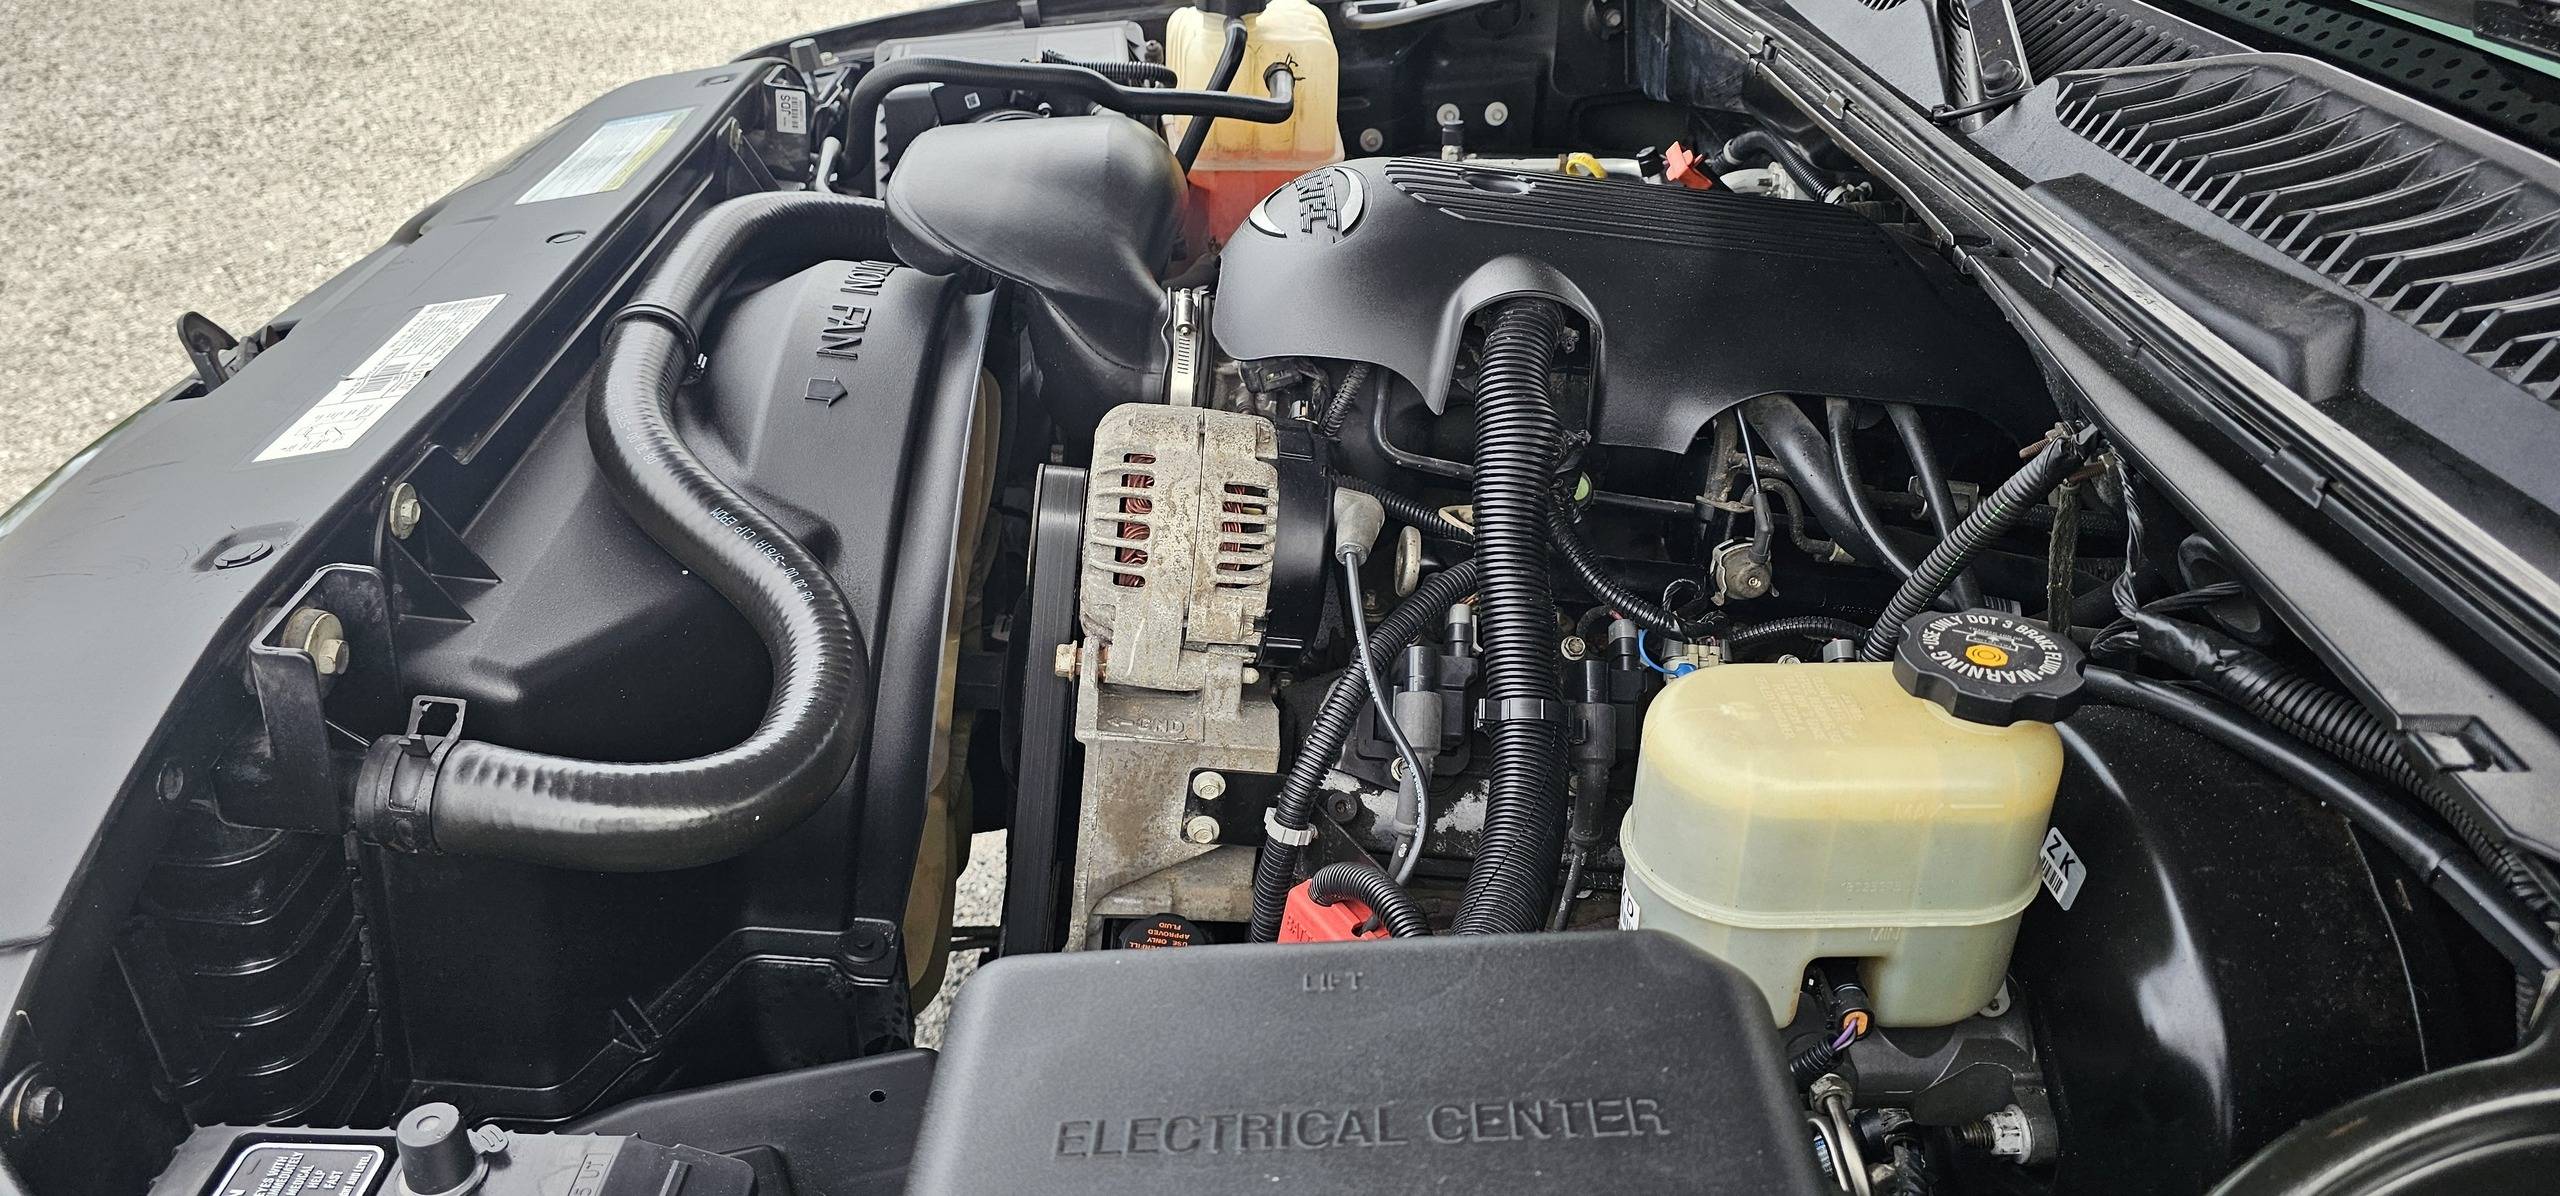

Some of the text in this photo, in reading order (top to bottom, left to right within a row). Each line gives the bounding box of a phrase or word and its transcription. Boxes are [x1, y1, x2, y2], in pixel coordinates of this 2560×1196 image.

[816, 305, 872, 360] FAN
[709, 506, 738, 527] EPDM
[792, 579, 808, 591] 30
[1922, 628, 1941, 646] USE
[1932, 615, 1964, 632] ONLY
[1966, 614, 1999, 625] DOT
[2002, 619, 2014, 629] 3
[2015, 624, 2058, 651] BRAKE
[2042, 651, 2062, 675] FLUID
[1930, 650, 2043, 684] WARNING
[1147, 929, 1191, 940] APPROVED
[1158, 922, 1181, 931] FLUID
[1146, 937, 1167, 945] ONLY
[1053, 1097, 1671, 1159] ELECTRICAL CENTER
[263, 1155, 289, 1178] WITH
[306, 1169, 326, 1189] HELP
[323, 1170, 344, 1190] FAST
